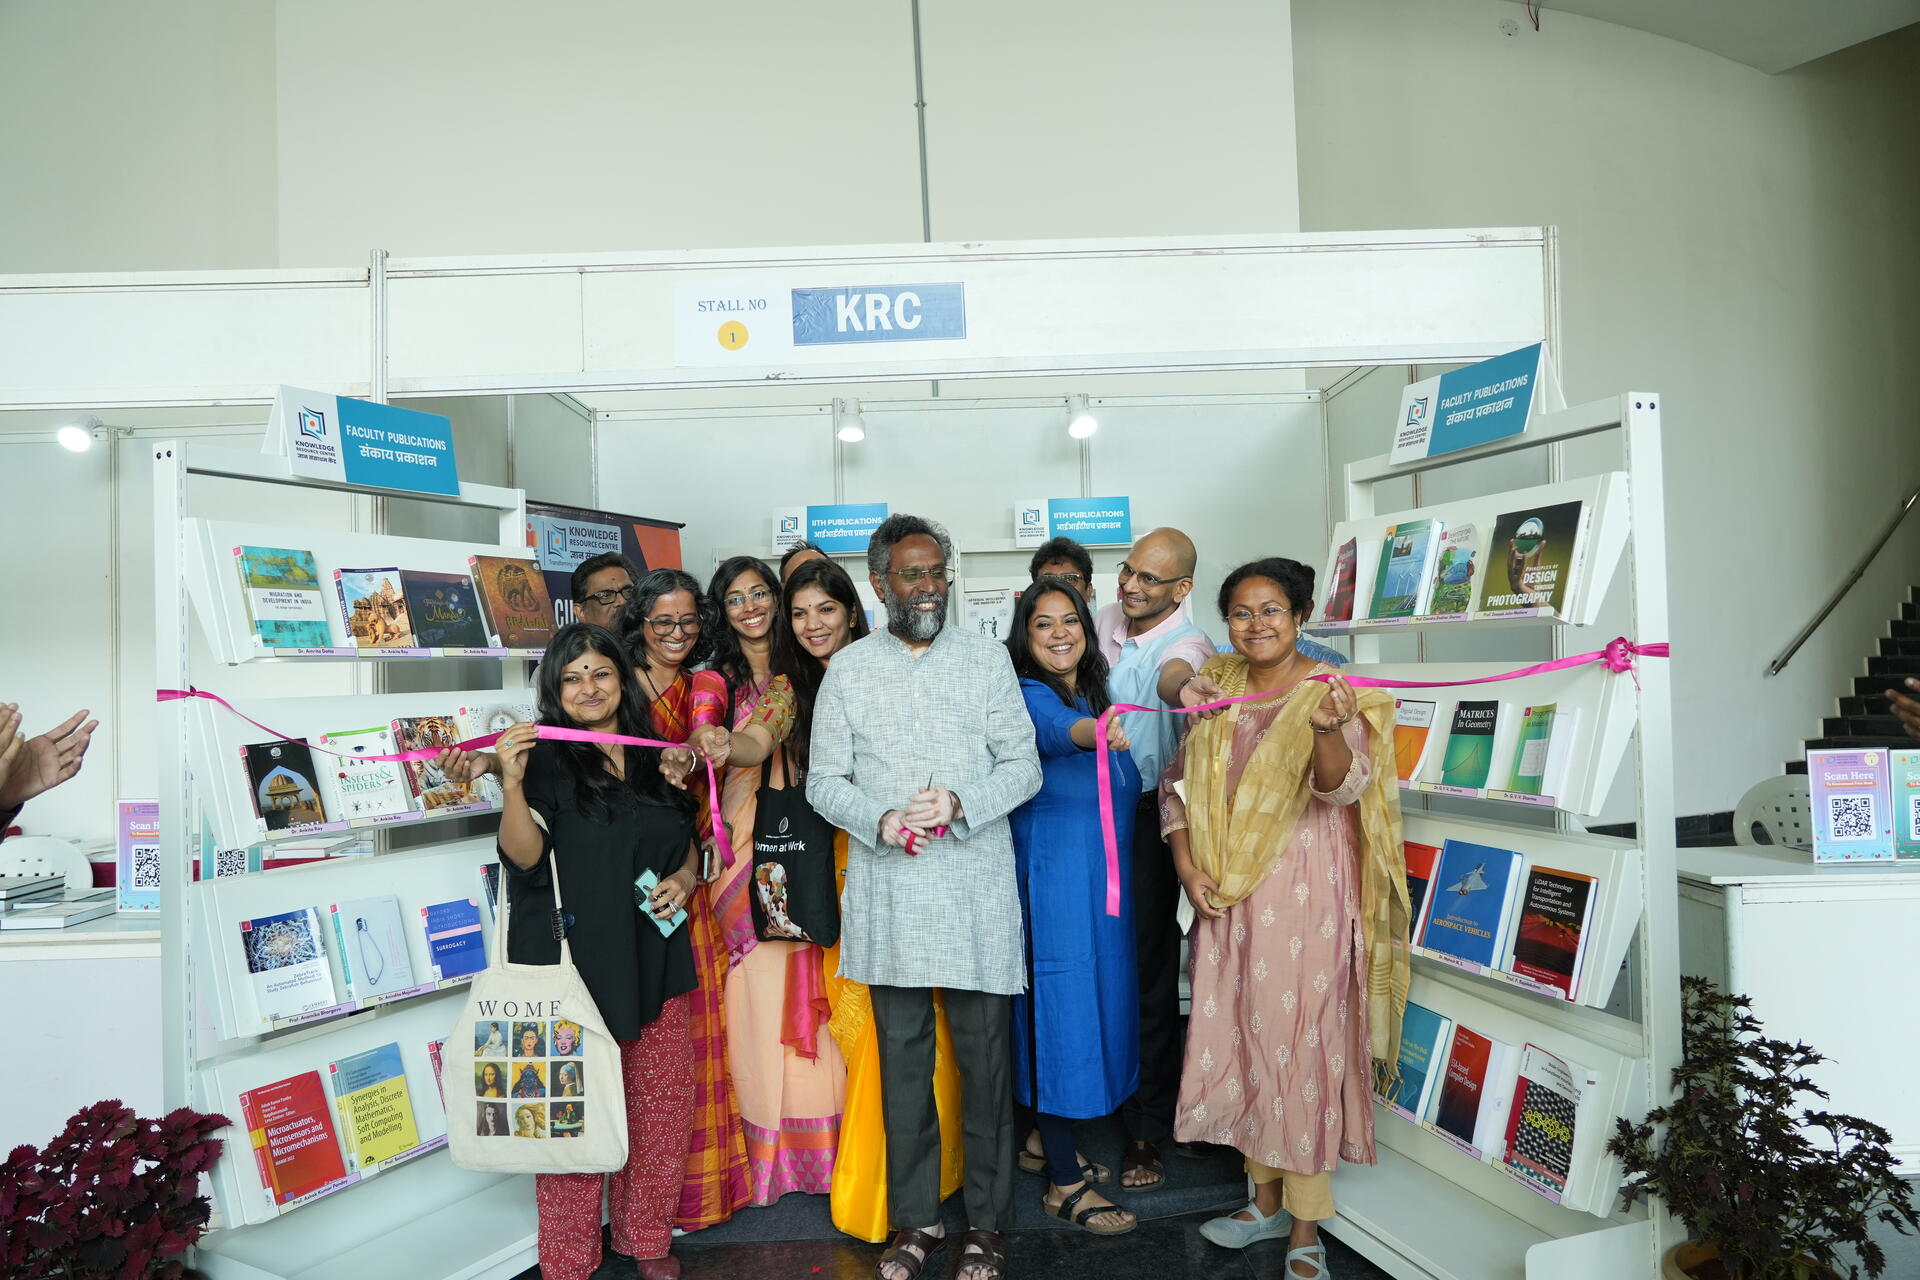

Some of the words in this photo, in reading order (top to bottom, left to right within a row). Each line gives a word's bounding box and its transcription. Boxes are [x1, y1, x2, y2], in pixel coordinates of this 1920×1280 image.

[698, 299, 744, 312] STALL
[748, 299, 767, 310] NO
[836, 291, 922, 332] KRC
[730, 333, 736, 343] 1
[1440, 391, 1472, 410] FACULTY
[1474, 375, 1528, 400] PUBLICATIONS
[1446, 409, 1474, 426] संकाय
[1476, 397, 1514, 418] प्रकाशन
[346, 425, 384, 441] FACULTY
[388, 432, 446, 450] PUBLICATIONS
[1400, 426, 1428, 437] KNOWLEDGE
[296, 440, 335, 452] KNOWLEDGE
[296, 447, 318, 455] RESOURCE
[359, 443, 394, 461] संकाय
[396, 450, 438, 468] प्रकाशन
[1070, 510, 1124, 518] PUBLICATIONS
[828, 517, 882, 526] PUBLICATIONS
[569, 526, 618, 541] KNOWLEDGE
[570, 539, 598, 547] RESOURCE
[598, 542, 618, 550] CENTRE
[1523, 570, 1557, 583] DESIGN
[1487, 592, 1553, 606] PHOTOGRAPHY
[1459, 710, 1494, 719] MATRICES
[1458, 719, 1464, 728] In
[1465, 720, 1492, 730] Geometry
[340, 773, 379, 785] INSECTS
[380, 768, 393, 779] &
[1824, 772, 1848, 780] Scan
[1850, 771, 1874, 780] Here
[341, 781, 382, 792] SPIDERS
[130, 822, 150, 830] Scan
[778, 843, 787, 852] at
[788, 841, 805, 851] Work
[1540, 887, 1561, 897] Intelligent
[1549, 880, 1573, 892] Technology
[1532, 894, 1562, 906] Transportation
[1529, 901, 1557, 913] Autonomous
[1558, 908, 1576, 918] Systems
[1432, 918, 1463, 931] AEROSPACE
[1464, 926, 1491, 938] VEHICLES
[436, 940, 466, 951] SURROGACY
[301, 1012, 320, 1020] Anamika
[351, 1088, 380, 1104] Synergies
[381, 1085, 387, 1093] in
[353, 1100, 380, 1114] Analysis,
[380, 1090, 403, 1104] Discrete
[355, 1104, 395, 1123] Mathematics,
[268, 1116, 316, 1137] Microactuators,
[357, 1124, 371, 1134] Soft
[371, 1111, 403, 1130] Computing
[270, 1128, 311, 1147] Microsensors
[311, 1123, 323, 1135] and
[360, 1133, 372, 1144] and
[372, 1122, 402, 1138] Modelling
[273, 1134, 328, 1157] Micromechanisms
[304, 1192, 317, 1201] Ashok
[318, 1186, 332, 1195] Kumar
[333, 1180, 348, 1188] Pandey
